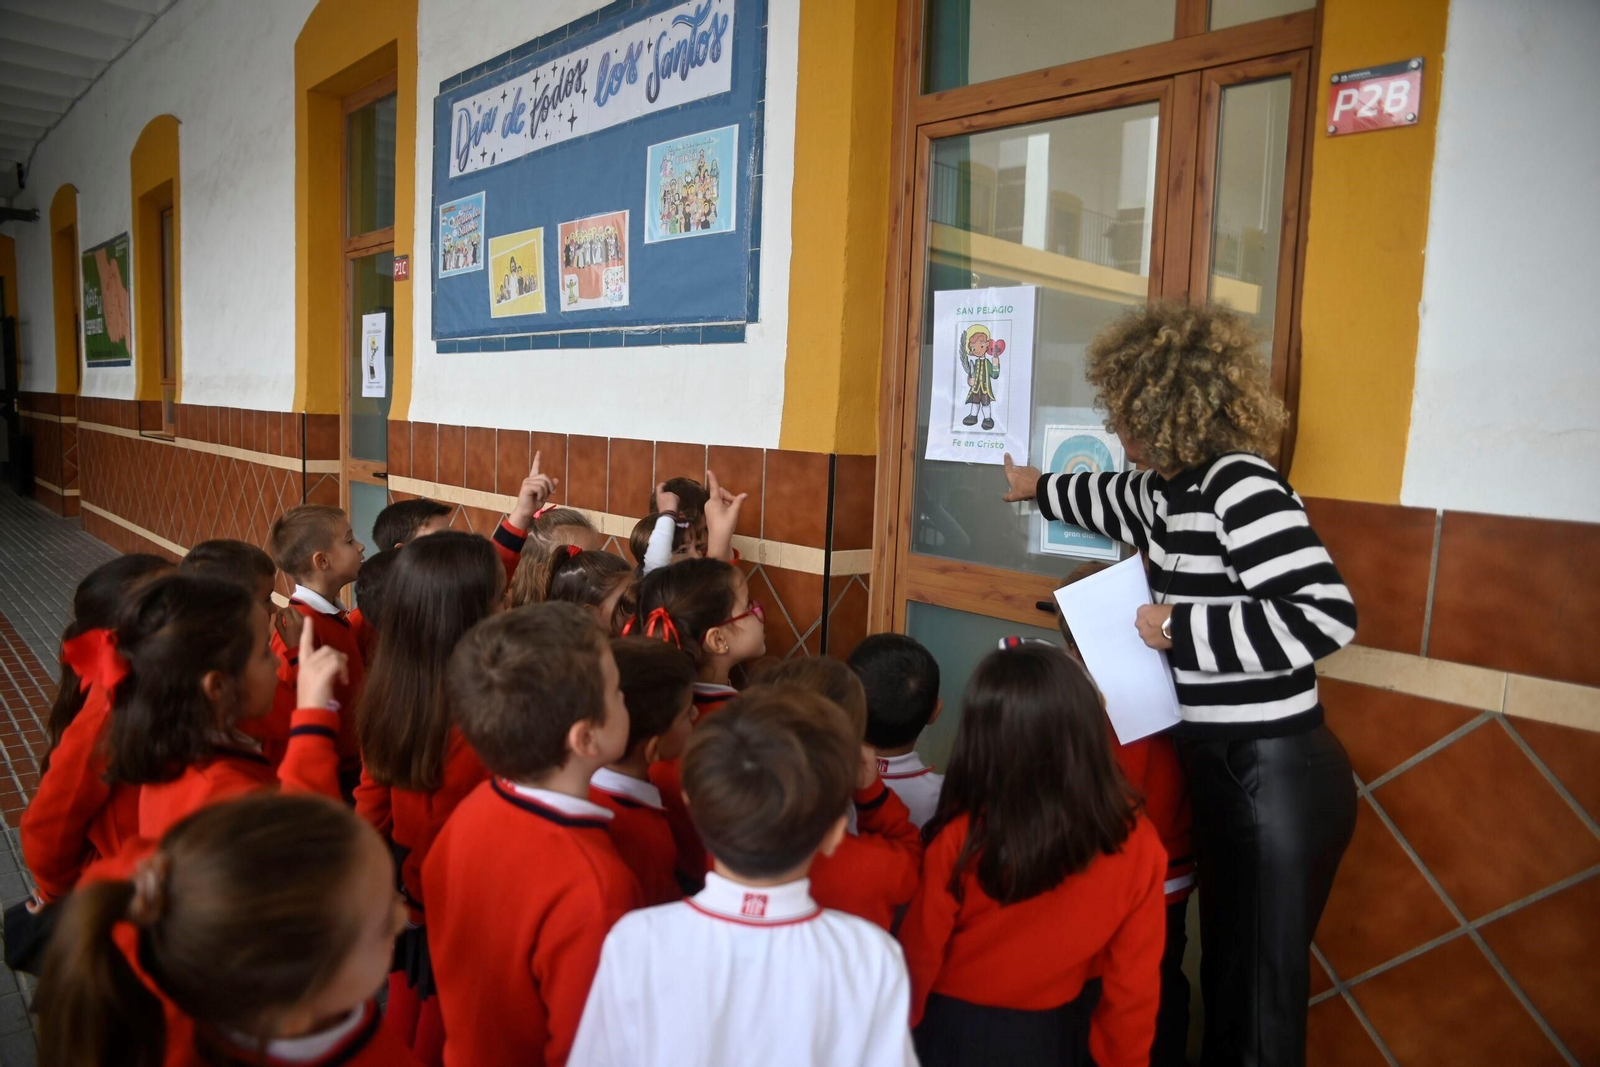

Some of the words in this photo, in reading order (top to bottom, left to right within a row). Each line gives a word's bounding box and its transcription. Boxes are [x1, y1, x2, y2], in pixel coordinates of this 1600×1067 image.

[501, 87, 527, 139] de
[530, 58, 589, 139] todos
[594, 41, 643, 107] los
[647, 0, 729, 103] Santos
[1333, 79, 1411, 122] P2B
[394, 261, 406, 275] P1C
[956, 307, 974, 316] SAN
[976, 305, 1014, 315] PELAGIO
[952, 438, 962, 447] Fe
[964, 440, 975, 448] en
[977, 439, 1005, 450] Cristo
[1063, 531, 1081, 539] gran
